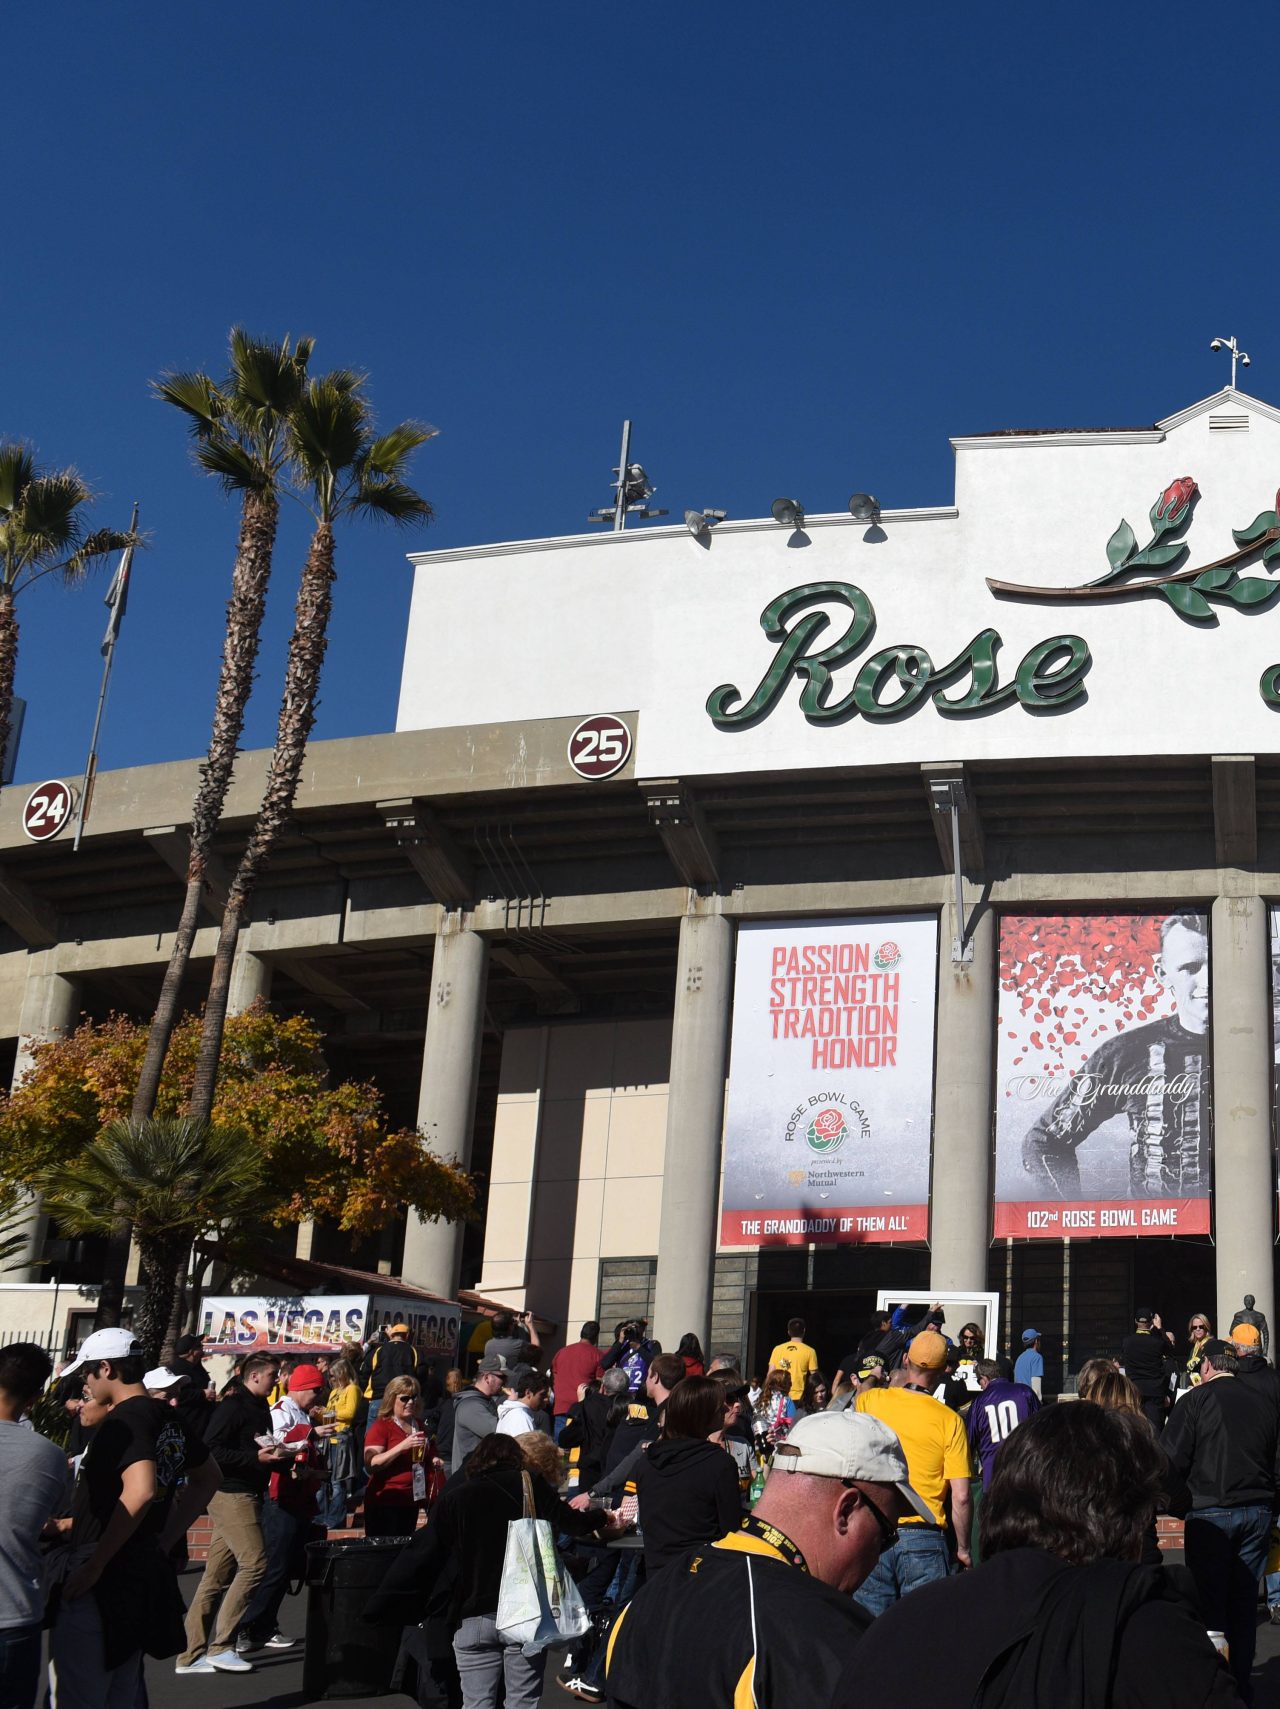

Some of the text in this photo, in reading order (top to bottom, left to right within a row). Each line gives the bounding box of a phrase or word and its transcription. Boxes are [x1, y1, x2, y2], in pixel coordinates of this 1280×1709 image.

[705, 580, 1092, 725] Rose
[574, 728, 624, 764] 25
[27, 793, 65, 828] 24
[772, 943, 870, 976] PASSION
[770, 972, 900, 1007] STRENGTH
[769, 1005, 899, 1040] TRADITION
[812, 1036, 897, 1069] HONOR
[1069, 1072, 1201, 1105] Granddaddy
[785, 1091, 871, 1142] ROSE BOWL GAME
[808, 1170, 865, 1179] Northwestern
[808, 1179, 837, 1187] Mutual
[741, 1215, 908, 1235] THE GRANDDADDY OF THEM ALL
[1027, 1208, 1178, 1228] 102nd ROSE BOWL GAME
[203, 1308, 364, 1346] LAS VEGAS
[984, 1400, 1019, 1444] 10
[762, 1531, 782, 1547] 2016
